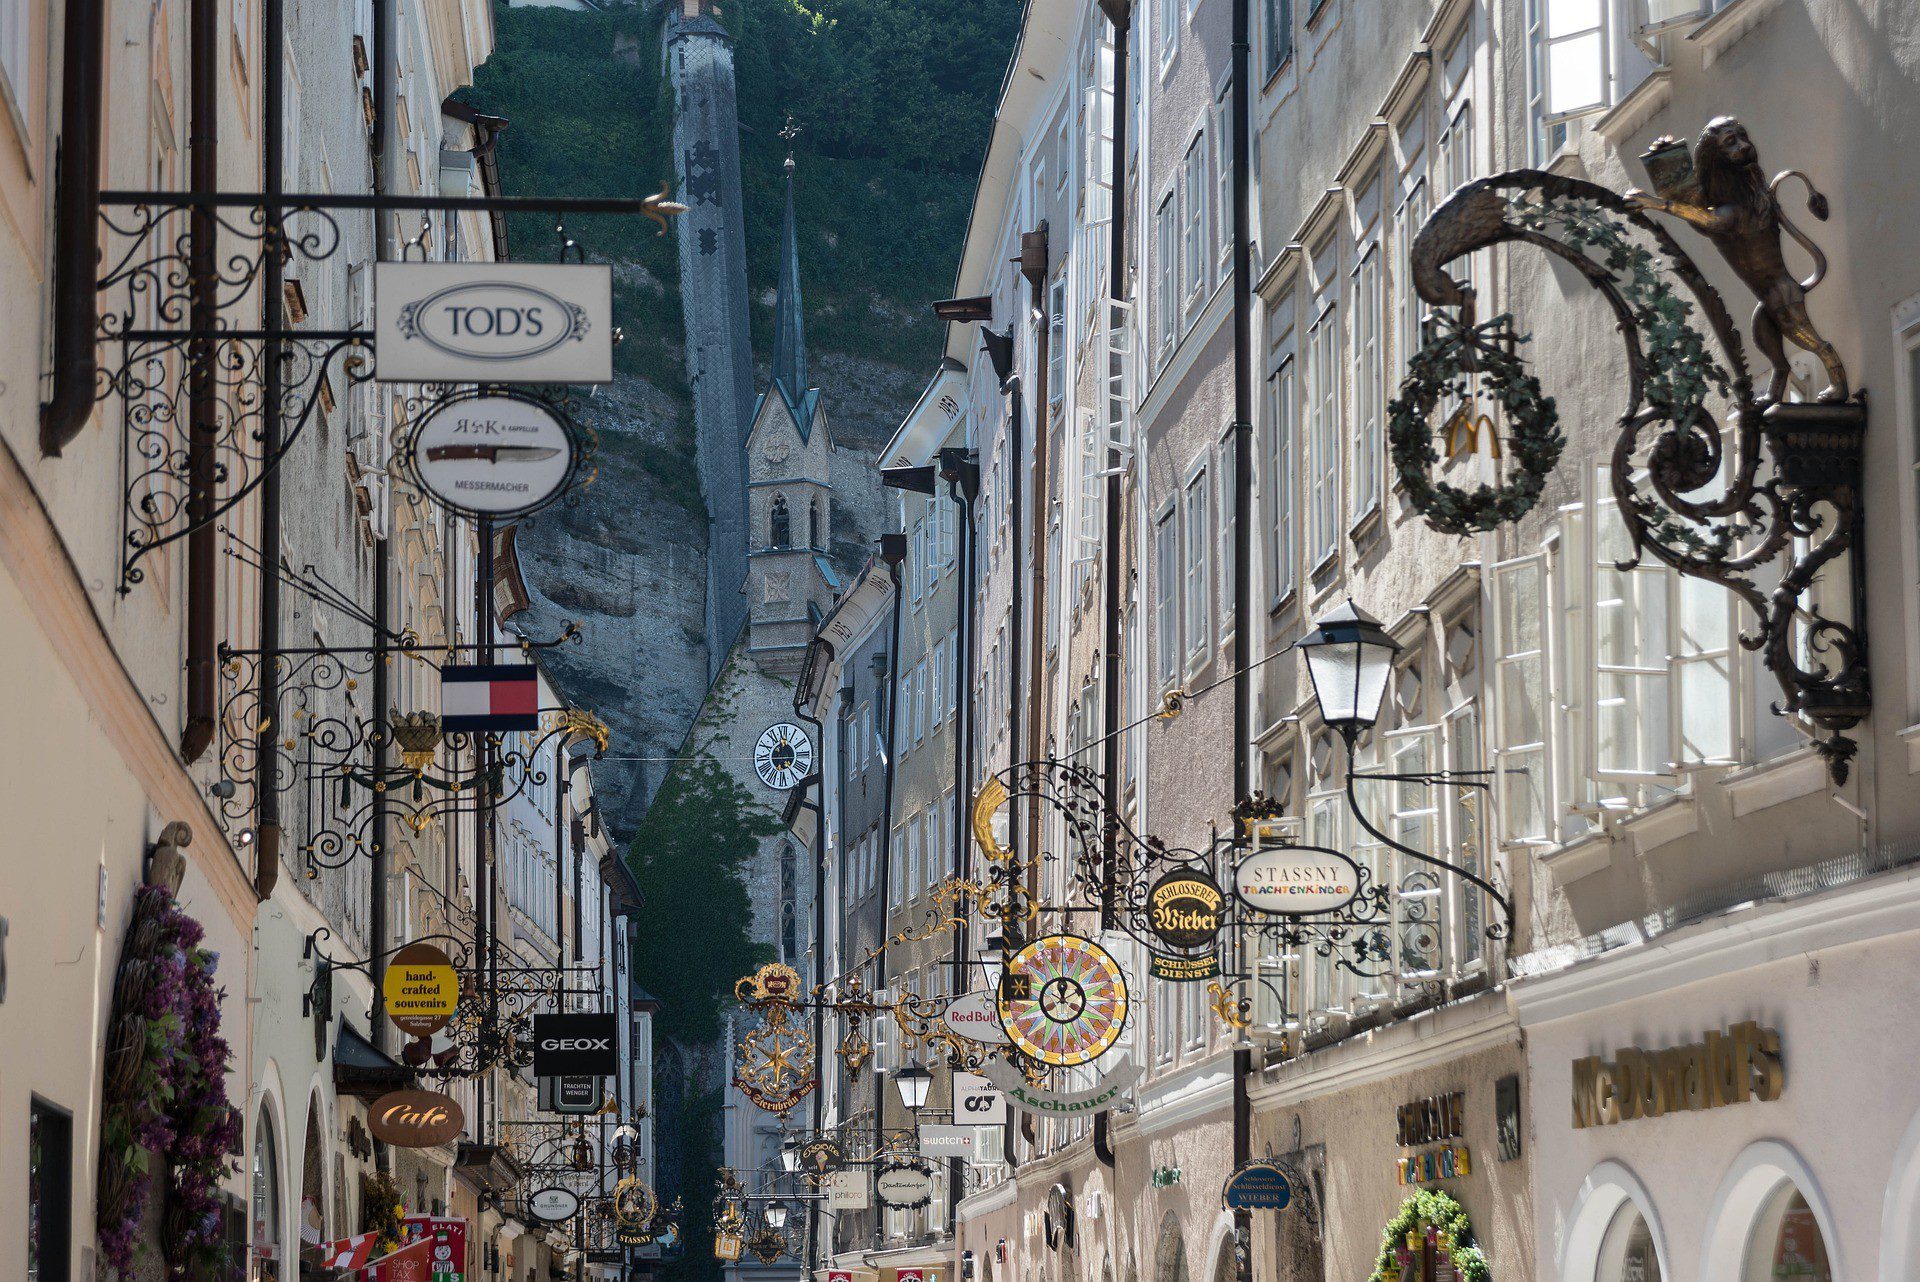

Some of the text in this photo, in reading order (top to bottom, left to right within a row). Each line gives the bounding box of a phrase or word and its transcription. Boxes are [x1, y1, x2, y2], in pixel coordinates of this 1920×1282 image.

[444, 306, 543, 336] TOD'S
[455, 480, 530, 492] MESSERMACHER
[1254, 866, 1340, 883] STASSNY
[1157, 883, 1217, 904] SCHLOSSEREI
[1243, 885, 1350, 895] TRACHTENKINDER
[1152, 906, 1217, 931] Wieber
[1154, 956, 1217, 969] SCHLÜSSEL
[406, 971, 436, 981] hand-
[1159, 967, 1211, 978] DIENST
[402, 984, 440, 995] crafted
[394, 998, 447, 1008] souvenirs
[951, 1011, 974, 1022] Red
[541, 1038, 609, 1051] GEOX
[1008, 1085, 1119, 1112] Aschauer
[382, 1104, 449, 1128] Café
[923, 1135, 963, 1145] swatch
[834, 1191, 863, 1200] philoro
[1239, 1193, 1280, 1202] WIEBER
[620, 1234, 651, 1244] STASSNY
[392, 1258, 419, 1270] SHOP
[393, 1269, 411, 1280] TAX
